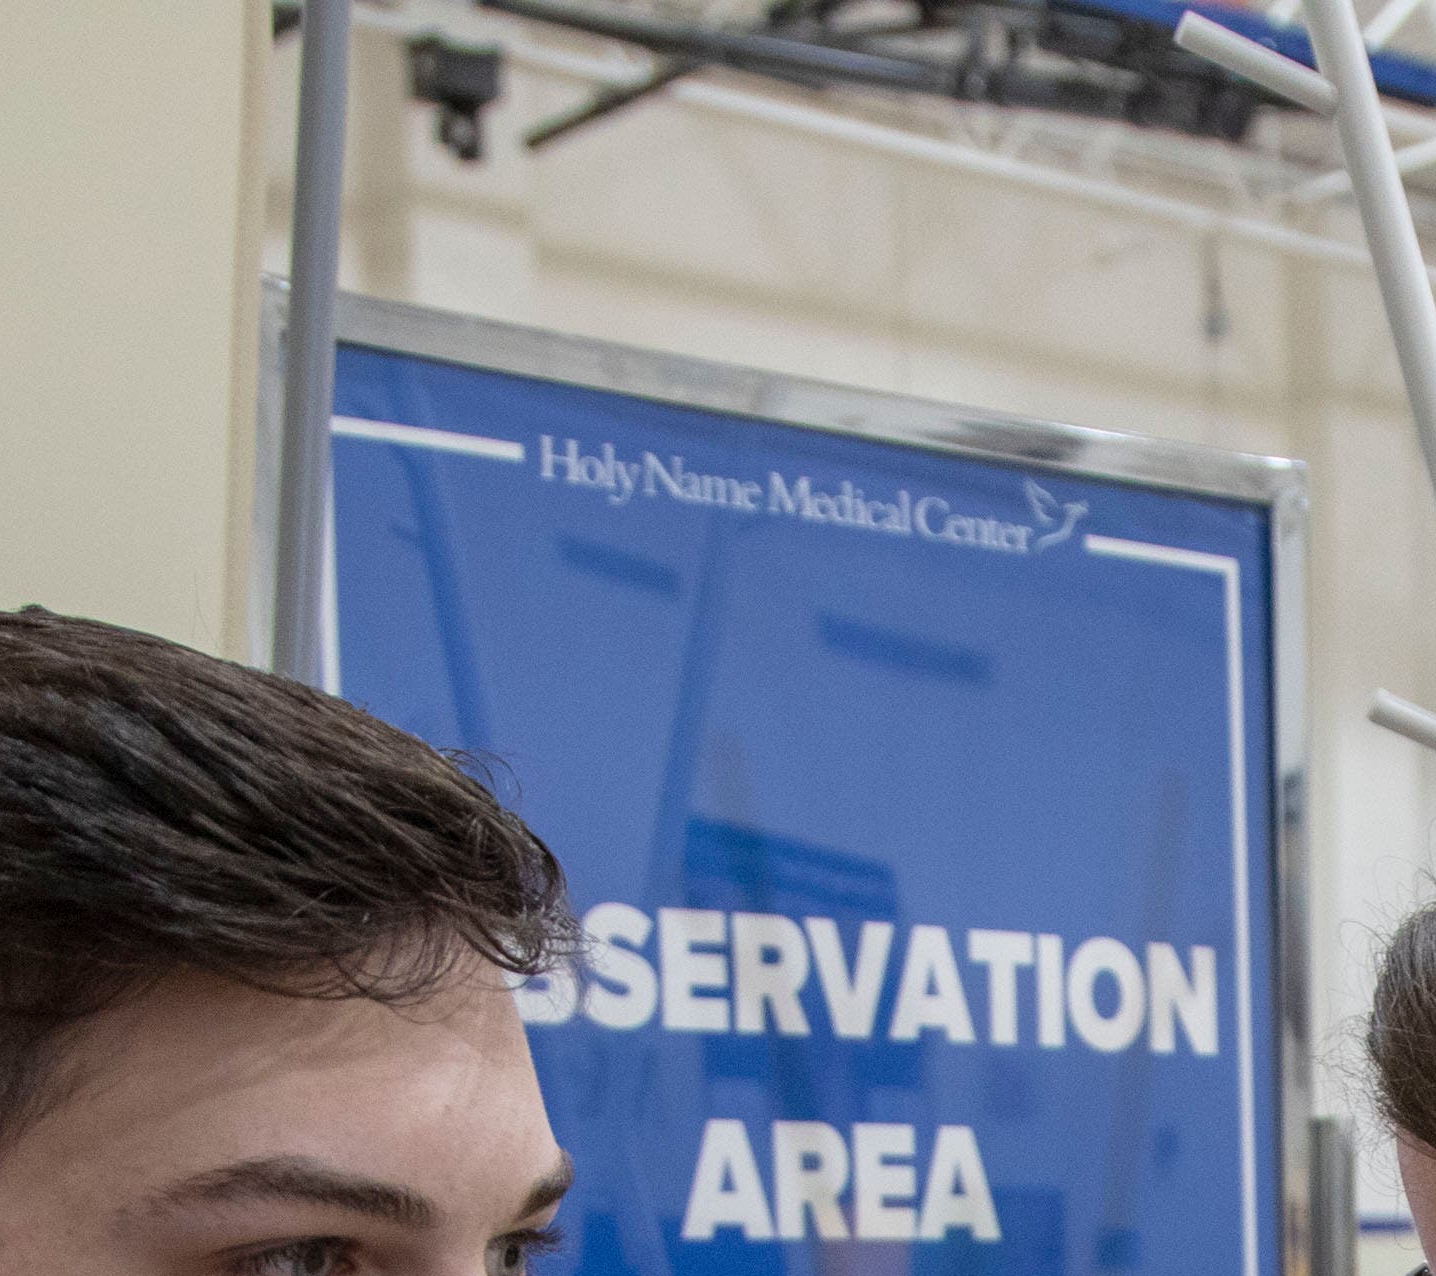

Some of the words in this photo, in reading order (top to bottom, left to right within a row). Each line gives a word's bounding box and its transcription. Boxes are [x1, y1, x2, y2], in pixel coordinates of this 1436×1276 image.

[538, 434, 640, 504] Holy
[641, 451, 761, 512] Name
[767, 470, 912, 533] Medical
[915, 495, 1034, 552] Center
[501, 901, 1220, 1055] SERVATION
[681, 1118, 1002, 1242] AREA
